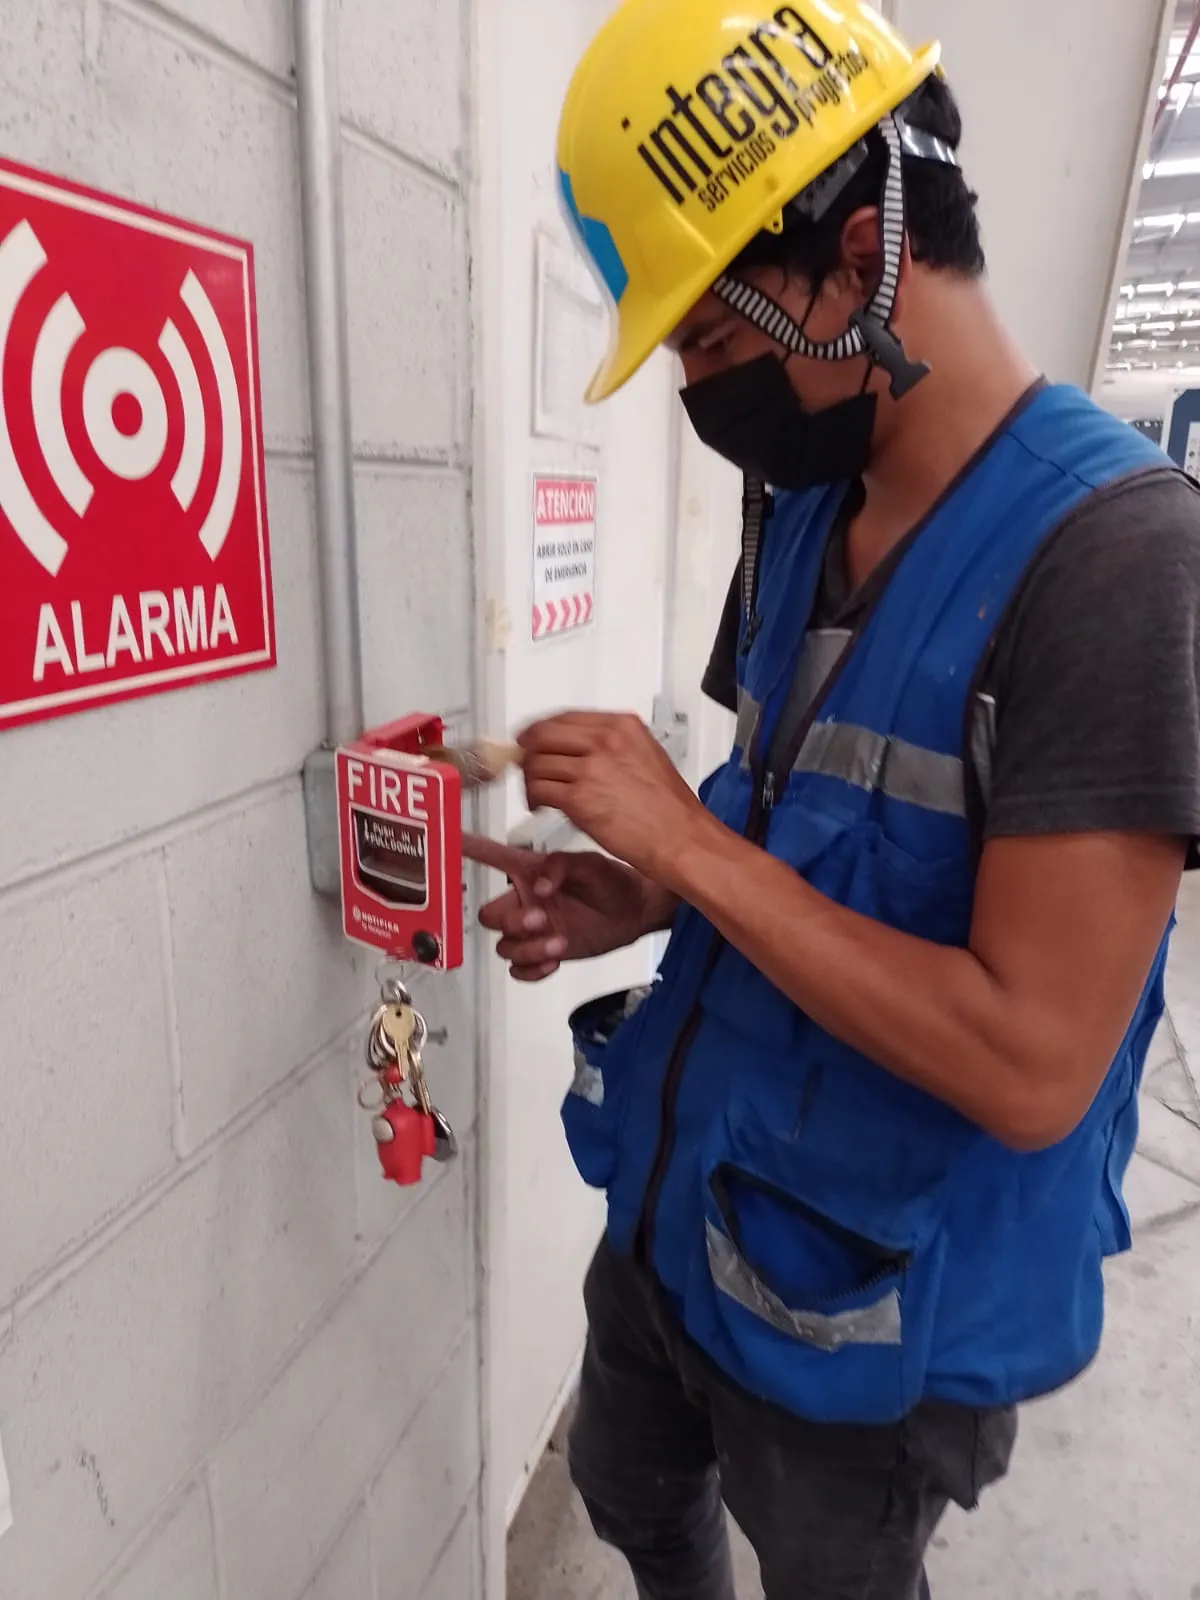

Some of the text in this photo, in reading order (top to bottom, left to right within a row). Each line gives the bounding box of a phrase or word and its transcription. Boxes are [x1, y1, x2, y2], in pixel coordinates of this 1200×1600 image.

[620, 5, 833, 207] integra
[698, 131, 777, 213] servicios
[33, 583, 239, 682] ALARMA
[347, 759, 428, 821] FIRE
